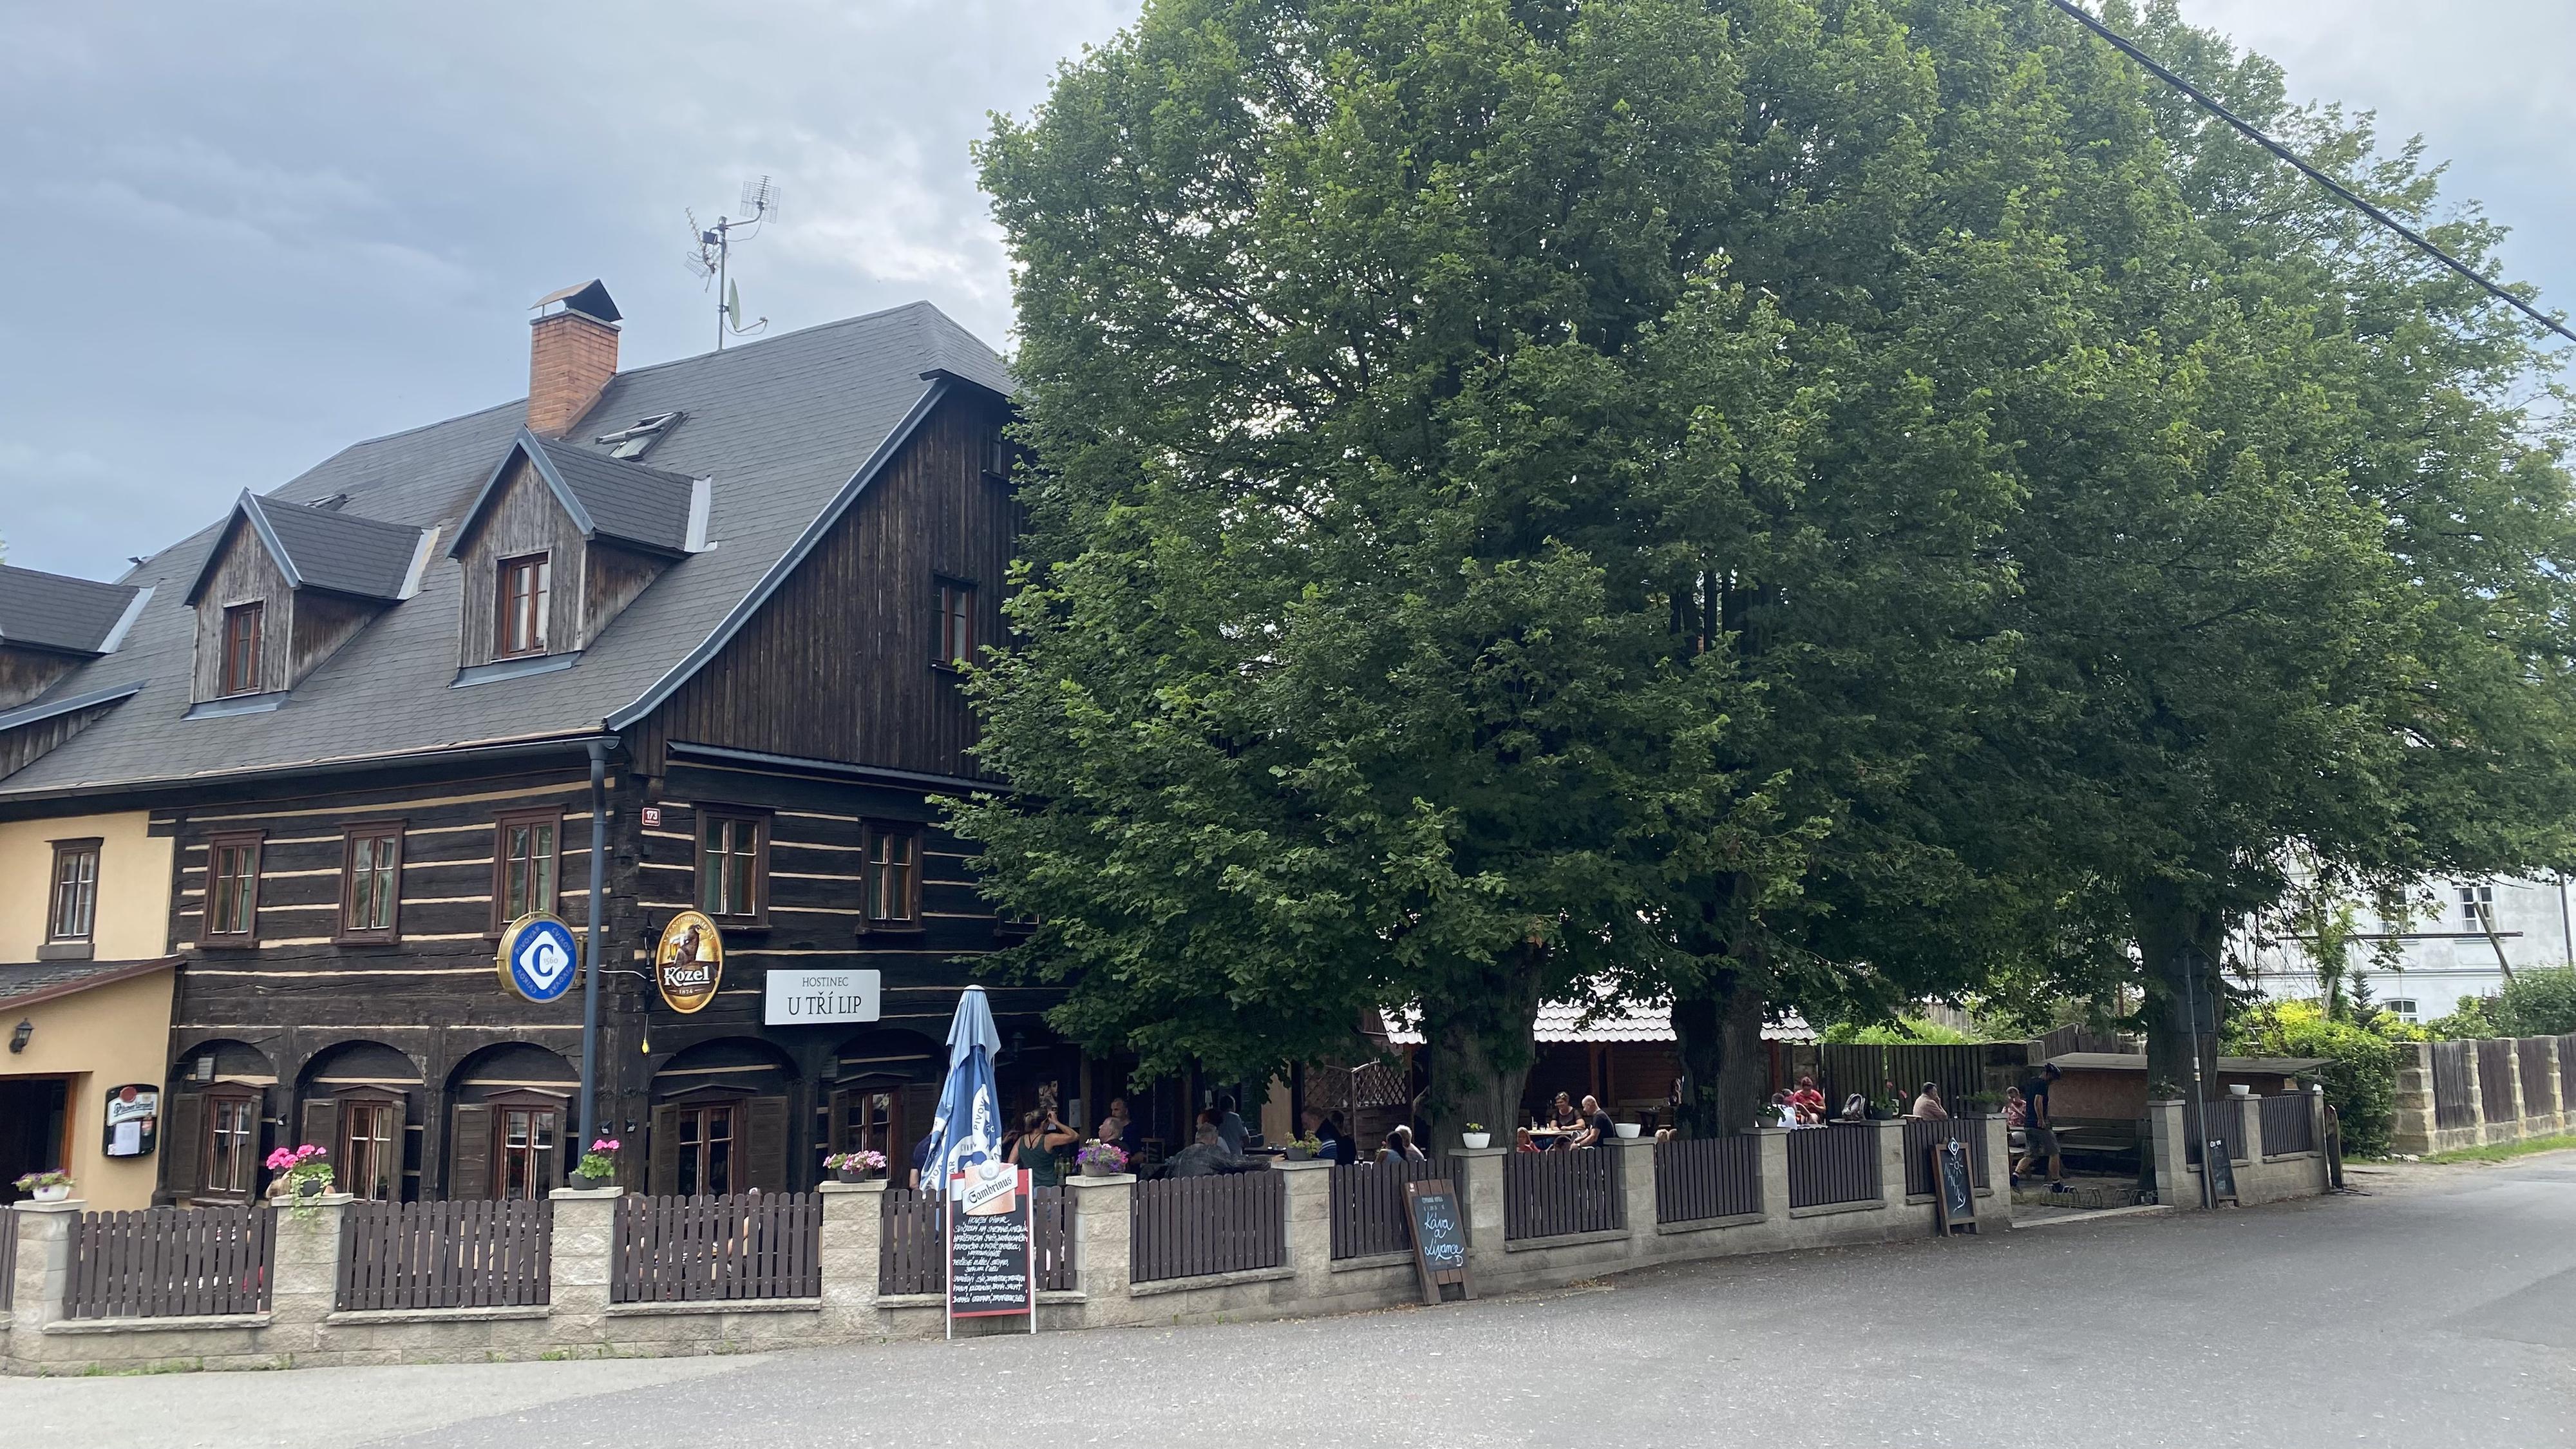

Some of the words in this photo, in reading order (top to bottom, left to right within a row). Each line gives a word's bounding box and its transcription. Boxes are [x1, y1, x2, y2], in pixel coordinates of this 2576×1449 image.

[647, 811, 658, 820] 173
[515, 925, 540, 954] PIVOVAR
[551, 927, 573, 952] CVIKOV
[532, 943, 554, 977] C
[543, 956, 558, 965] 1560
[516, 969, 536, 994] CVIKOV
[548, 966, 573, 995] PIVOVAR
[663, 965, 710, 987] Kozel
[802, 977, 849, 987] HOSTINEC
[788, 997, 801, 1015] U
[806, 991, 833, 1014] TŘÍ
[838, 996, 862, 1014] LIP
[974, 1098, 985, 1131] PIVOV
[969, 1176, 1012, 1203] Gambrinus
[1425, 1211, 1454, 1231] Káva
[1434, 1229, 1446, 1238] a
